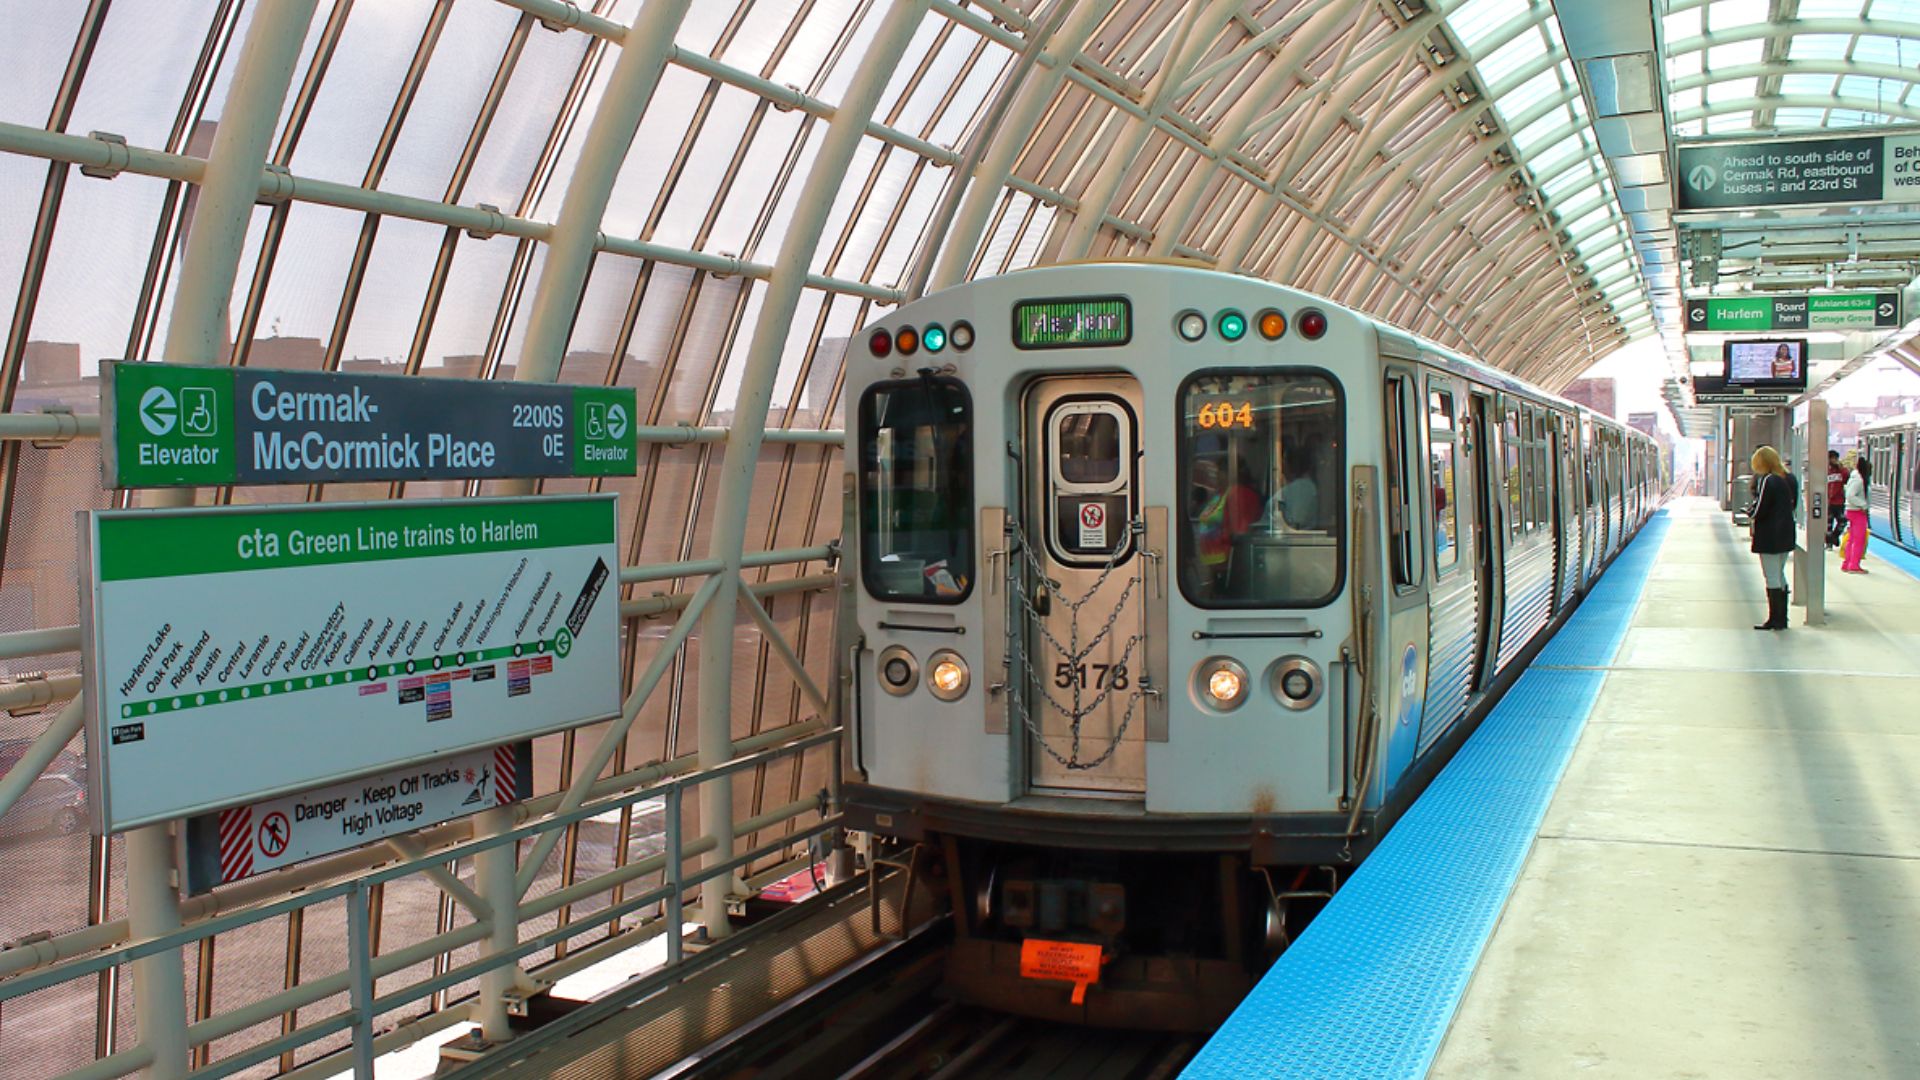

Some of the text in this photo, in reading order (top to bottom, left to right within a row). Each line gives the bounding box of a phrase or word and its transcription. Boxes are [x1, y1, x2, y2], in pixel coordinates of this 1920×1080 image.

[1723, 148, 1872, 167] Ahead to south side of
[1723, 163, 1874, 182] Cermak Rd, eastbound
[1895, 161, 1908, 172] of
[1723, 177, 1858, 195] buses and 23rd St
[1716, 308, 1764, 320] Harlem
[1775, 302, 1806, 312] Board
[1778, 313, 1802, 322] here
[1812, 314, 1874, 324] Cottage Grove
[252, 380, 378, 422] Cermak-
[512, 404, 564, 428] 2200S
[1198, 402, 1253, 428] 604
[138, 443, 220, 466] Elevator
[253, 430, 496, 470] McCormick Place
[543, 434, 564, 458] 0E
[584, 444, 628, 461] Elevator
[237, 519, 538, 558] cta Green Line trains to Harlem
[476, 557, 528, 644] Washington/Wabash
[514, 571, 553, 640] Adams/Wabash
[537, 592, 562, 636] Roosevelt
[301, 601, 345, 671] Conservatory
[344, 618, 374, 665] California
[368, 617, 394, 660] Ashland
[387, 620, 411, 658] Morgan
[406, 620, 428, 656] Clinton
[434, 601, 464, 652] Clark/Lake
[456, 599, 486, 648] State/Lake
[120, 623, 172, 696] Harlem/Lake
[146, 641, 184, 694] Oak Park
[170, 630, 210, 690] Ridgeland
[196, 647, 222, 686] Austin
[218, 640, 247, 684] Central
[239, 634, 270, 680] Laramie
[262, 640, 287, 677] Cicero
[282, 630, 310, 672] Pulaski
[324, 631, 347, 667] Kedzie
[295, 797, 347, 822] Danger
[362, 784, 396, 808] Keep
[399, 776, 420, 796] Off
[422, 768, 460, 790] Tracks
[342, 802, 424, 837] High Voltage
